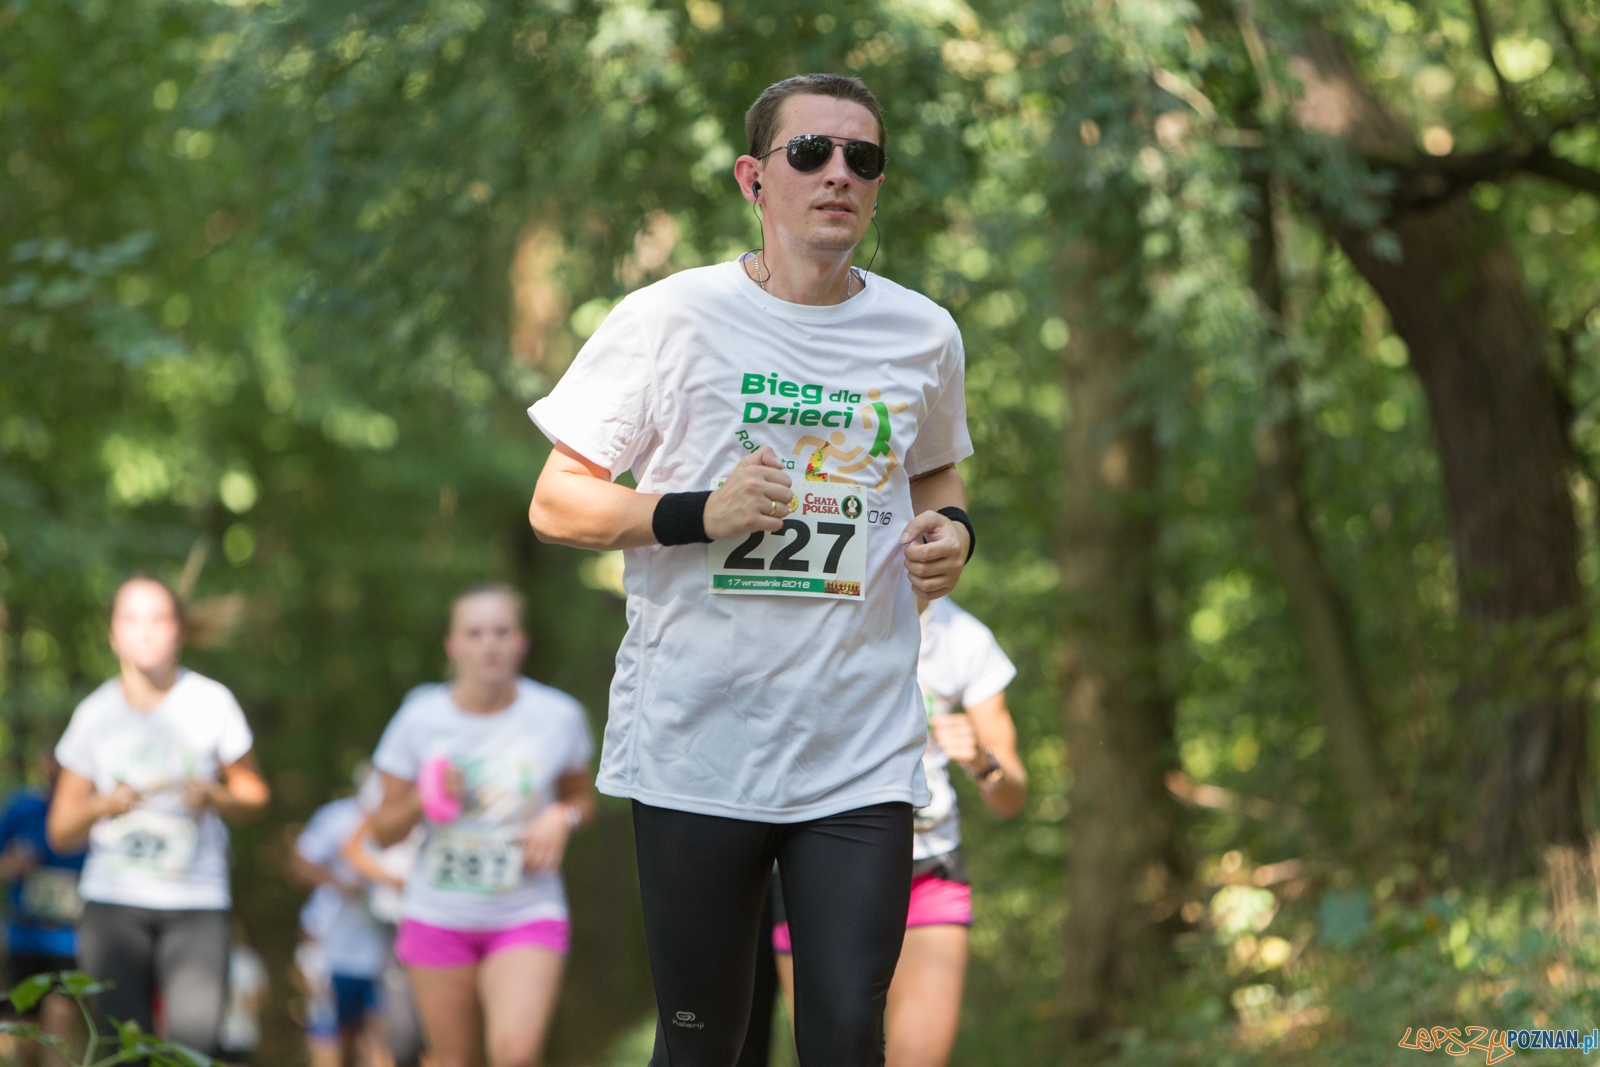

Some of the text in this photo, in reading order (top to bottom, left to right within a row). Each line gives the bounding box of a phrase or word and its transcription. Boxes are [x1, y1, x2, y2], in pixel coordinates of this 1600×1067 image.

[741, 372, 862, 405] Bieg dla
[742, 402, 854, 429] Dzieci
[867, 510, 893, 525] 016
[723, 519, 856, 574] 227
[727, 578, 741, 587] 17
[781, 580, 811, 589] 2016
